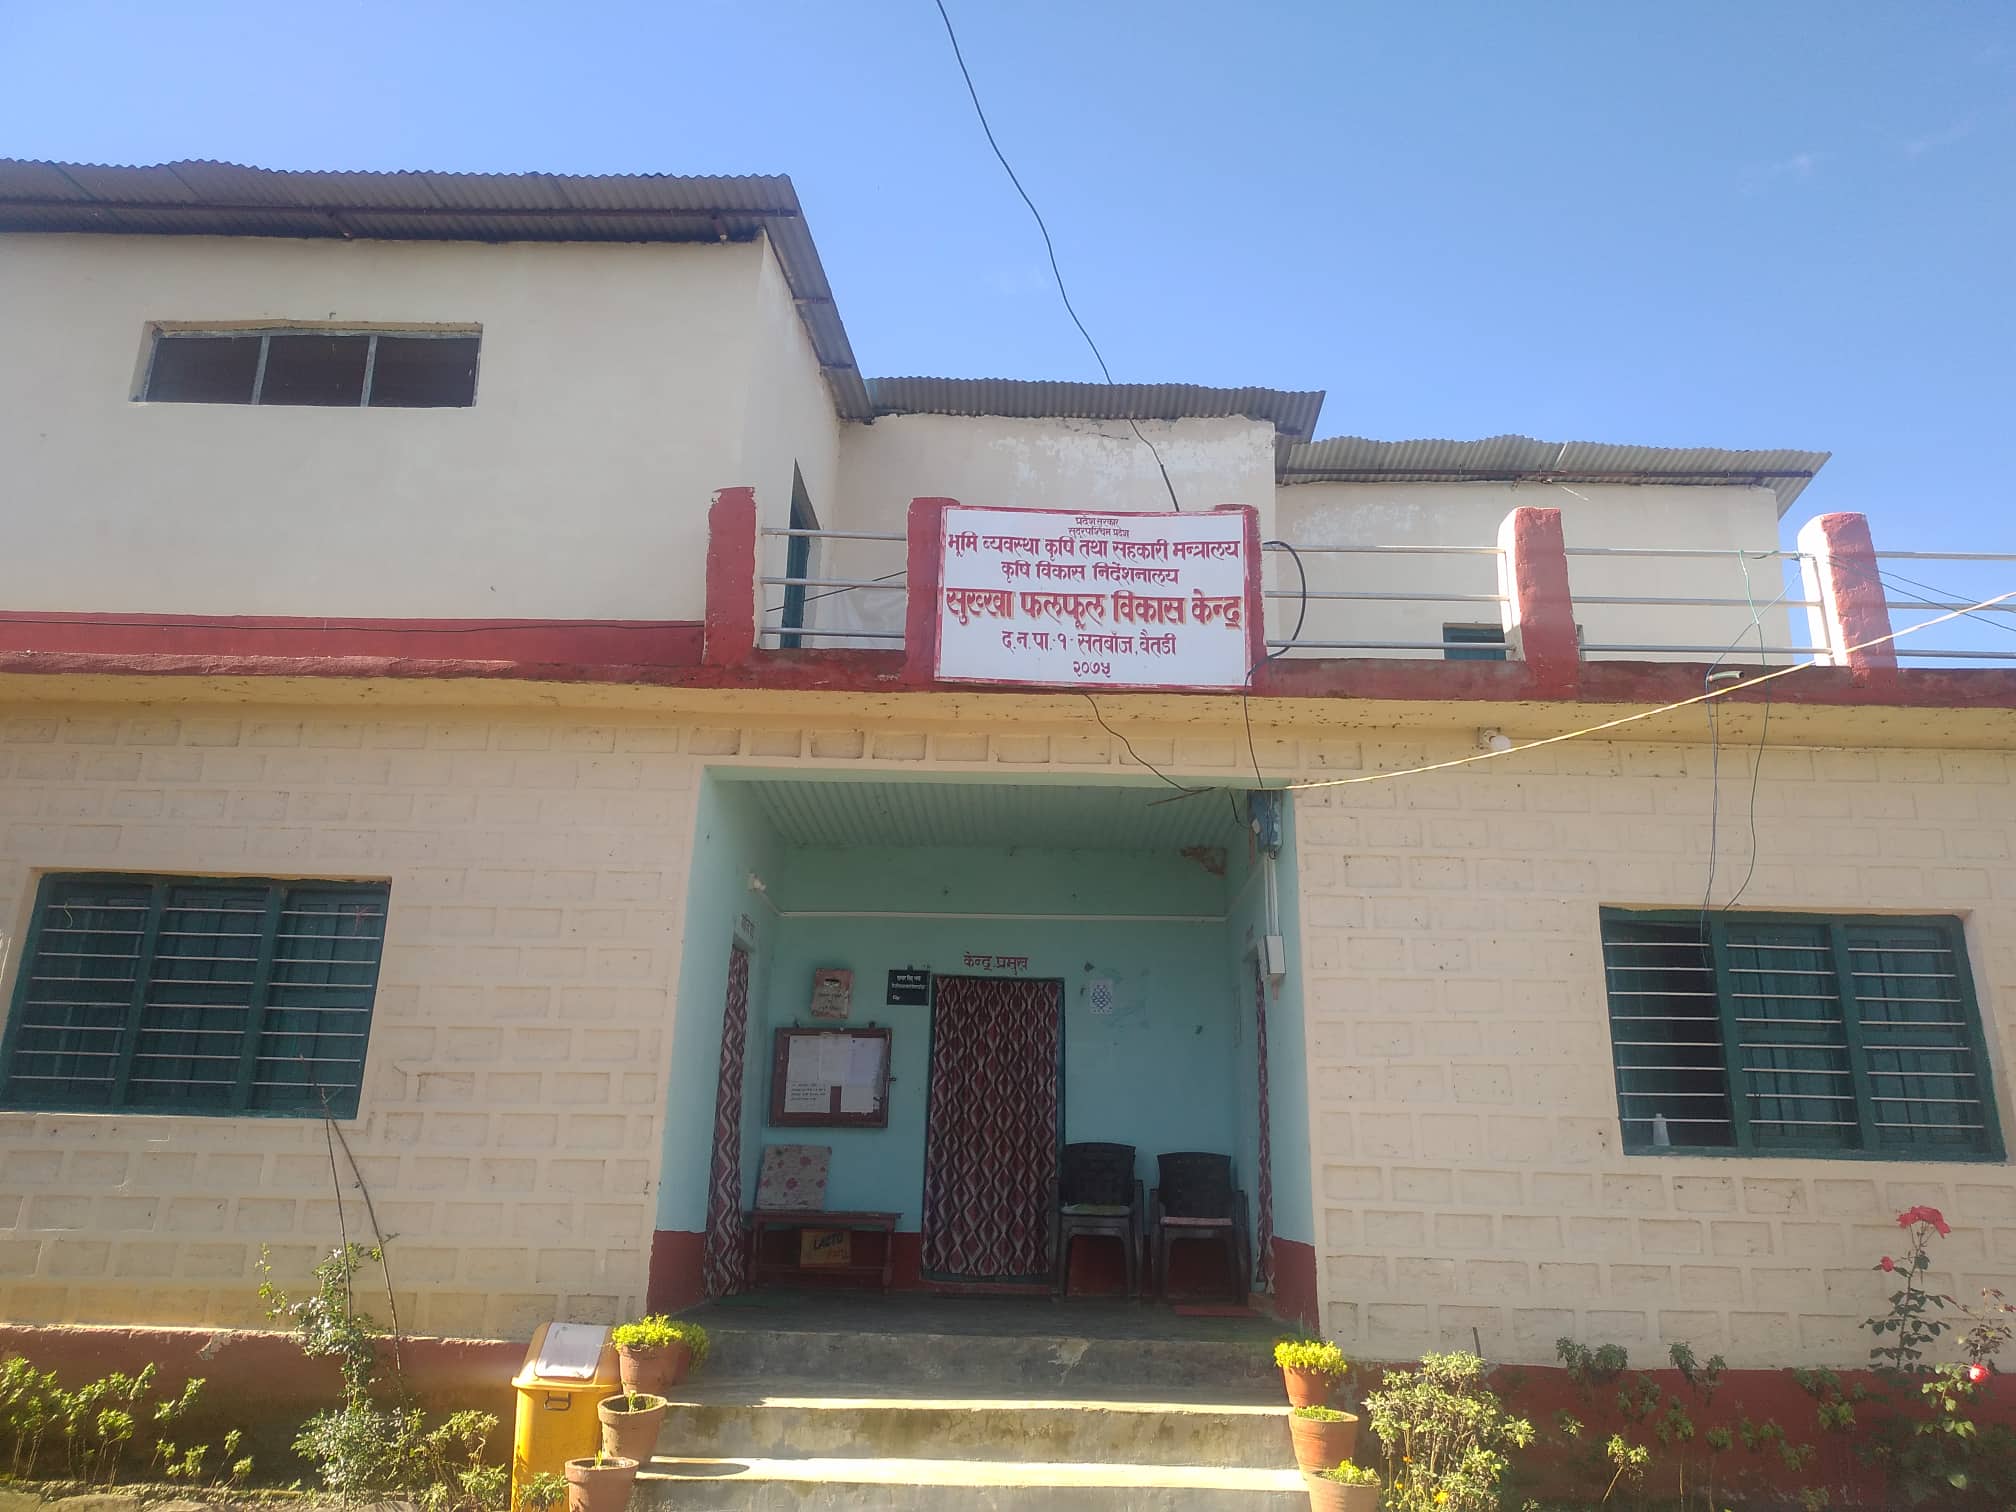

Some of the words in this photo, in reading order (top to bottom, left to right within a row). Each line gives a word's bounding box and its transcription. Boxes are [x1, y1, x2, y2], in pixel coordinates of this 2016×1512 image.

[948, 531, 978, 557] भूमि
[982, 535, 1040, 557] व्यवस्था
[1045, 536, 1075, 561] कृषि
[1079, 540, 1108, 559] तथा
[1112, 539, 1169, 563] सहकारी
[1173, 541, 1240, 561] मन्त्रालय
[1001, 560, 1031, 583] कृषि
[1035, 560, 1086, 582] विकास
[1020, 592, 1105, 630] फलफूल
[1111, 590, 1186, 625] विकास
[1191, 588, 1242, 629] केन्द्र
[1073, 660, 1111, 678] २०७५
